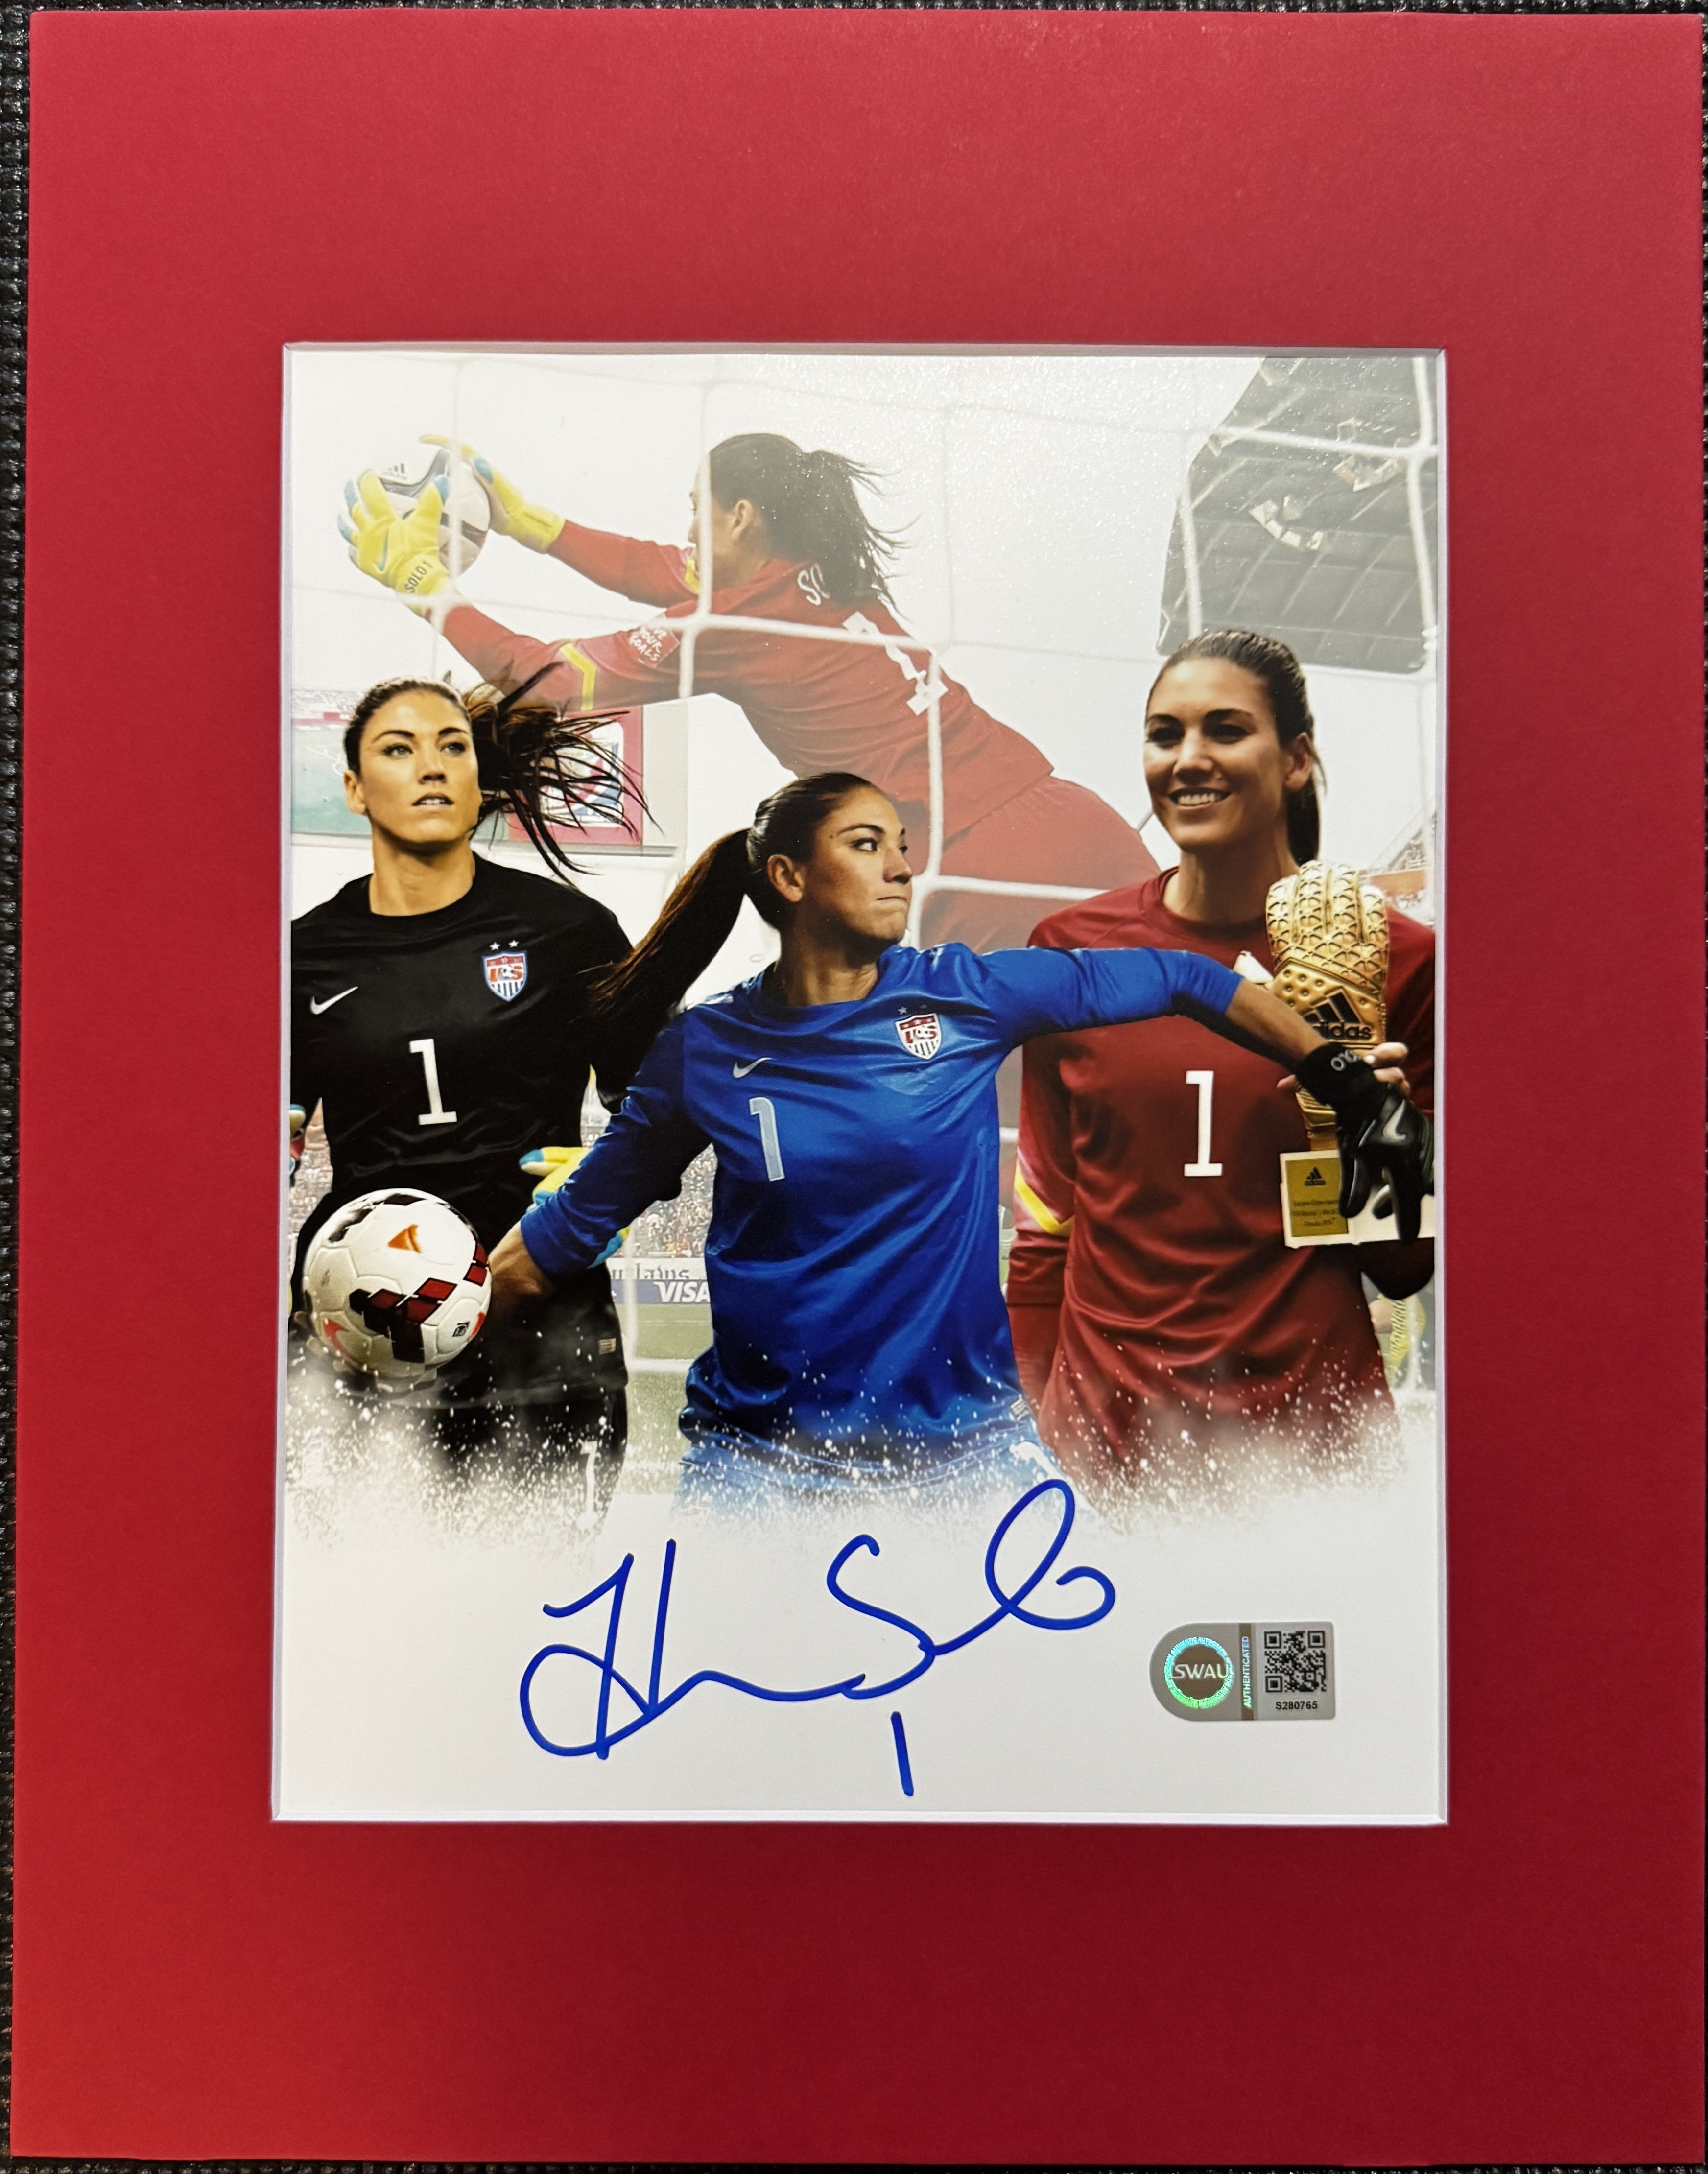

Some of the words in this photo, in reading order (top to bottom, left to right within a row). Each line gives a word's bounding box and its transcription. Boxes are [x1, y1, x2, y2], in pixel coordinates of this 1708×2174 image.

[404, 566, 427, 593] SOLO
[628, 631, 661, 662] GOALS
[409, 1038, 457, 1125] 1
[749, 1096, 785, 1182] 1
[1184, 1070, 1223, 1177] 1
[653, 1281, 711, 1302] VISA
[1171, 1663, 1229, 1679] SWAU
[1241, 1635, 1253, 1710] AUTHENTICATED
[1275, 1701, 1318, 1710] S280765
